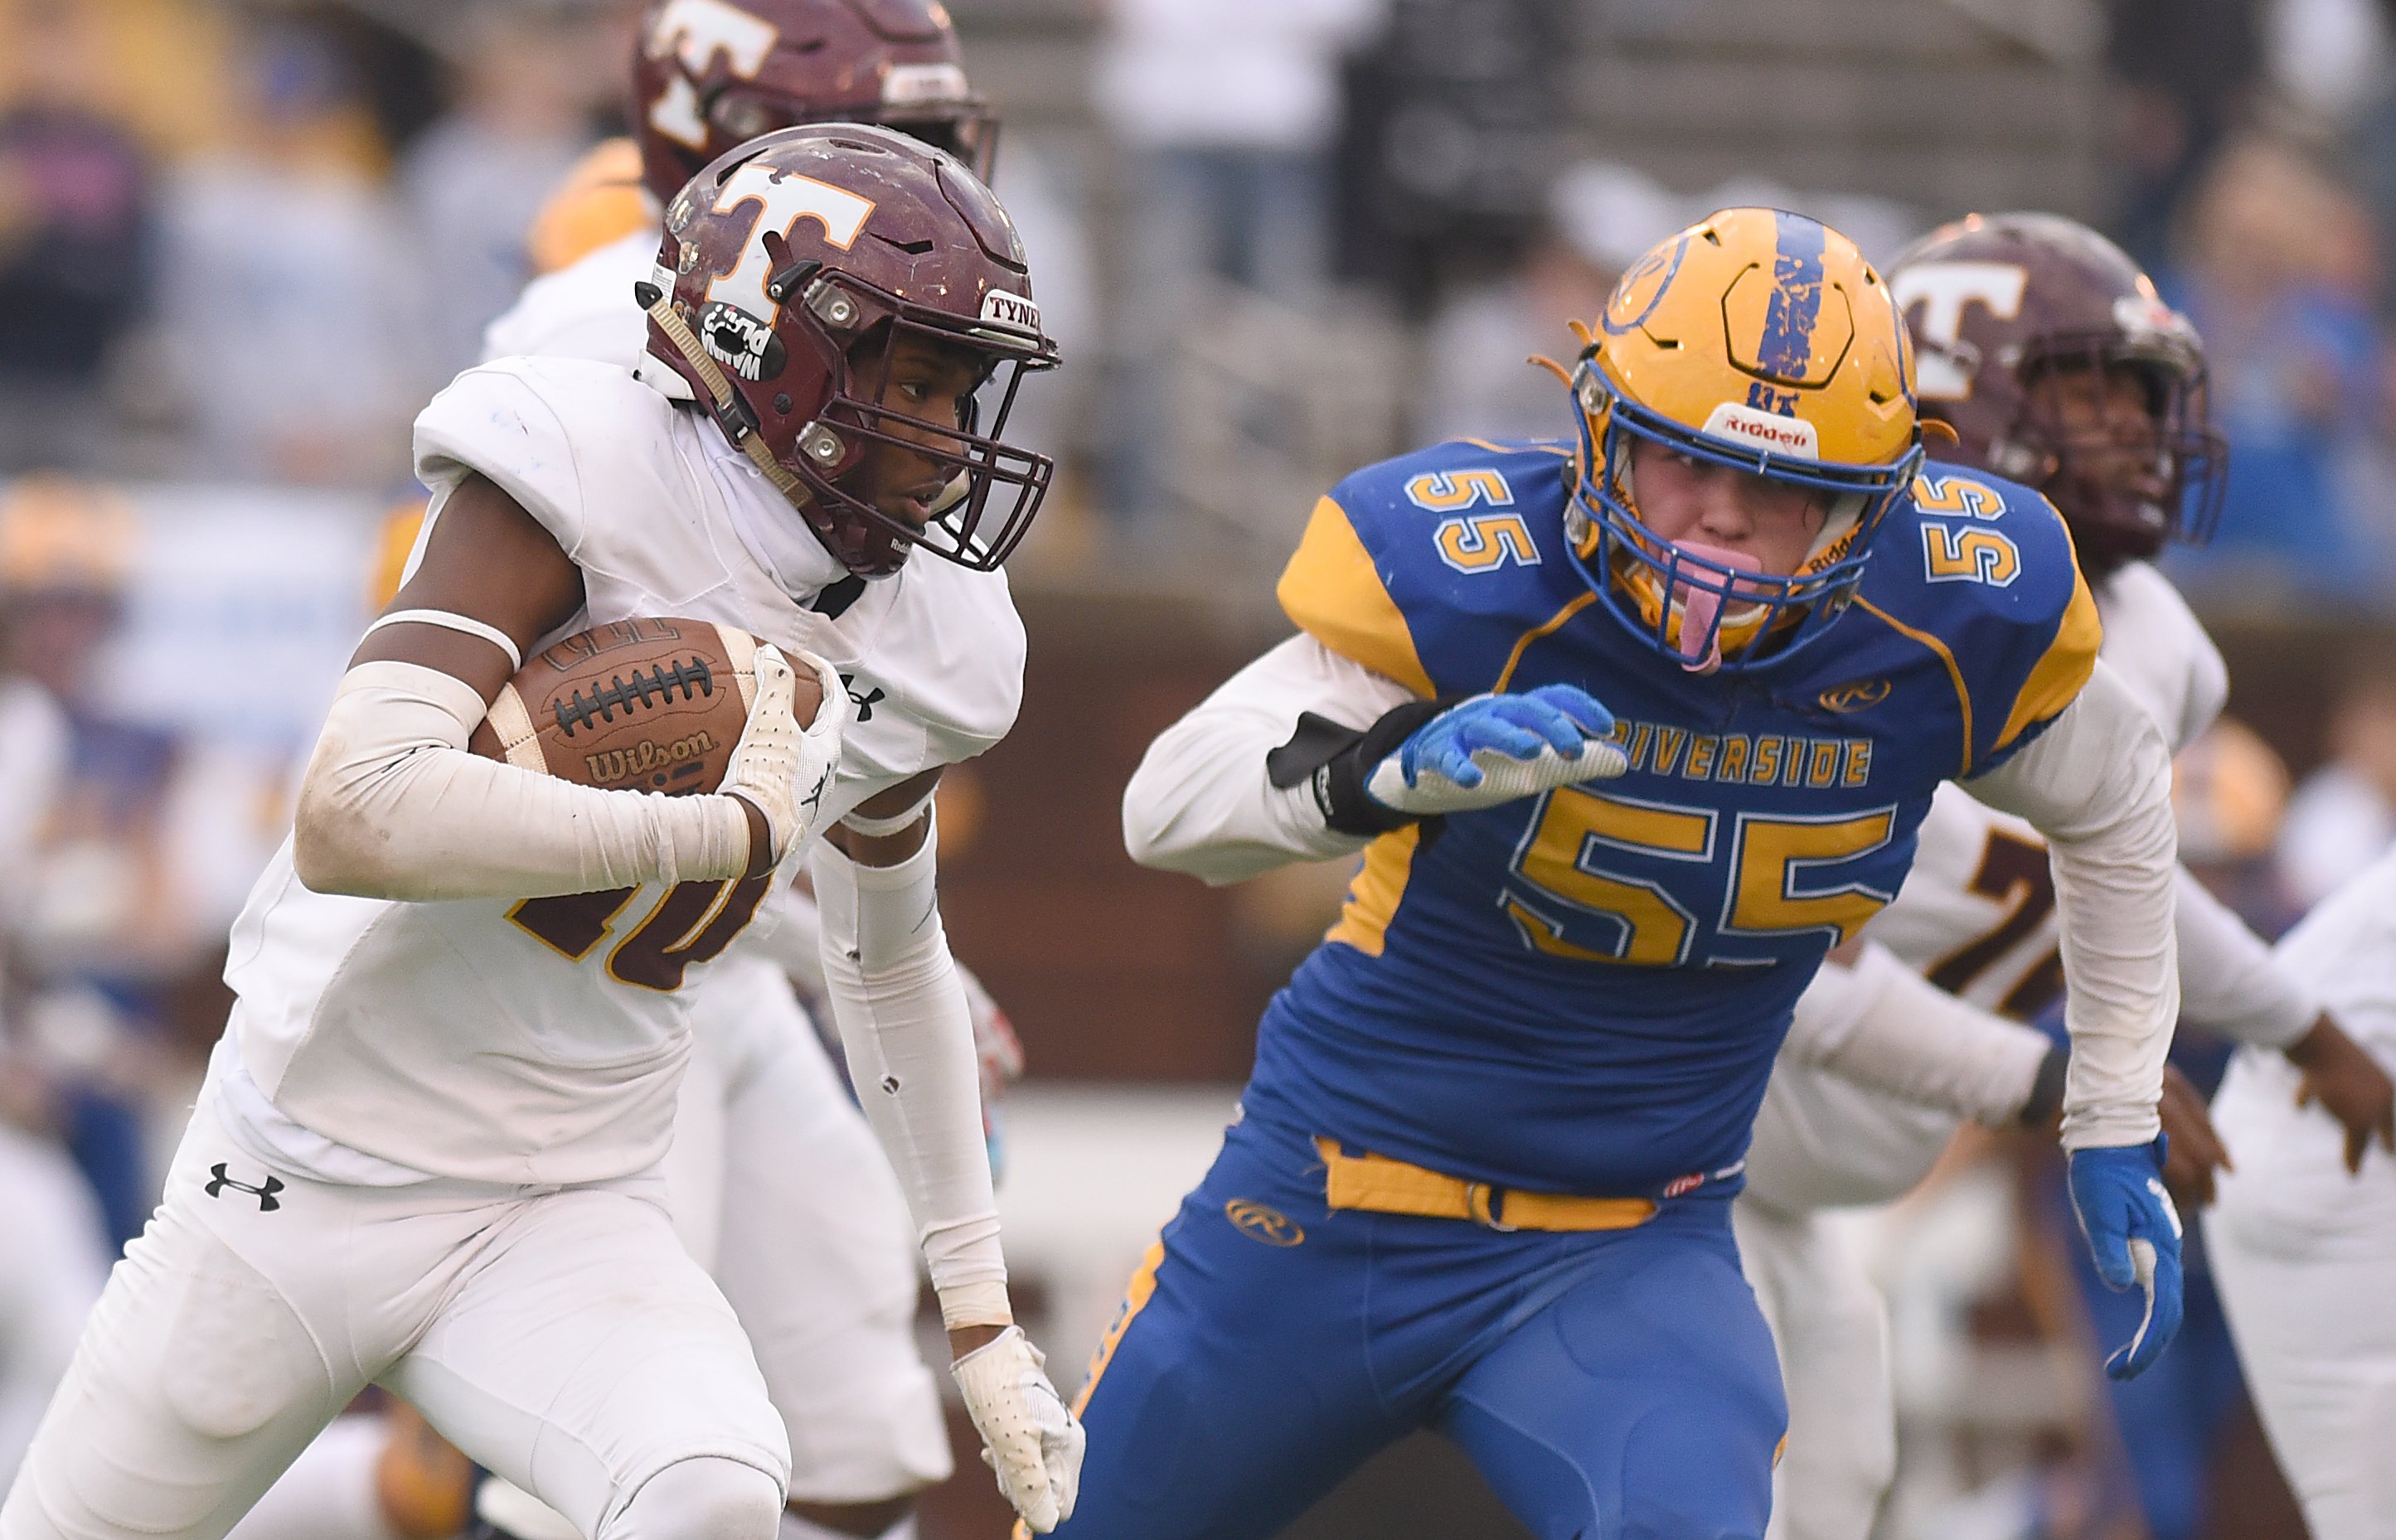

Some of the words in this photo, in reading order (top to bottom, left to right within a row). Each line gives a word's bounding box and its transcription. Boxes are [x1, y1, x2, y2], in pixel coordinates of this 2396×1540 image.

[705, 165, 876, 333] T
[1888, 262, 2030, 402] T
[1404, 468, 1542, 574] 55
[1913, 474, 2021, 588] 55
[585, 730, 715, 783] Wilson
[1496, 783, 1899, 967] 55
